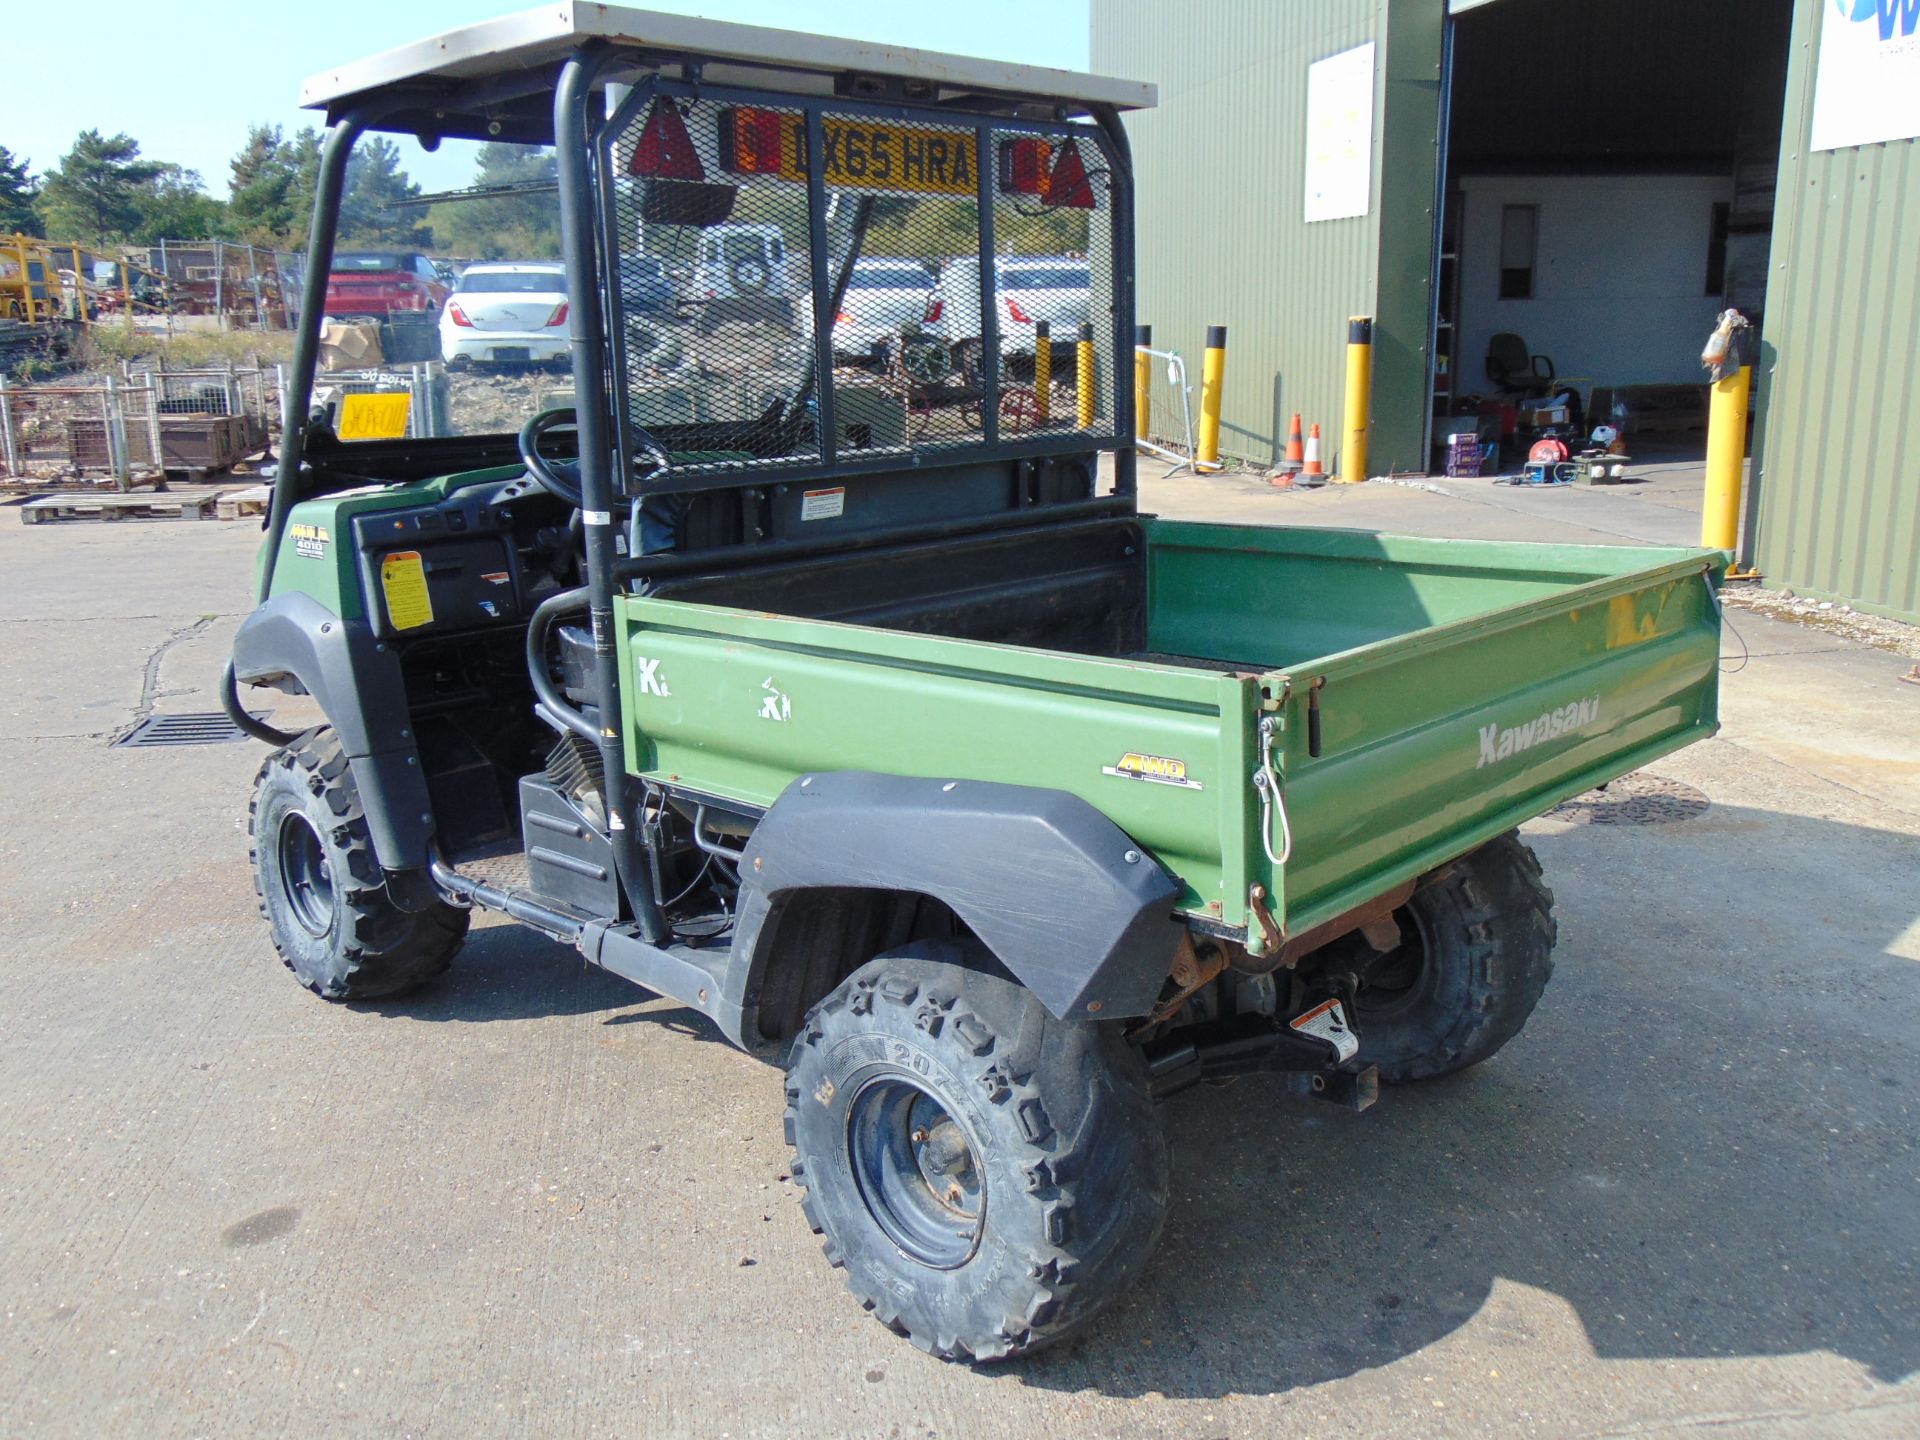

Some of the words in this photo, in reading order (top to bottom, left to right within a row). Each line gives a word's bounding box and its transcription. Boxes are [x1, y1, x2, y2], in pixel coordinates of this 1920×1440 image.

[902, 134, 970, 186] HRA
[296, 540, 323, 551] 4010
[1476, 692, 1600, 769] Kawasaki
